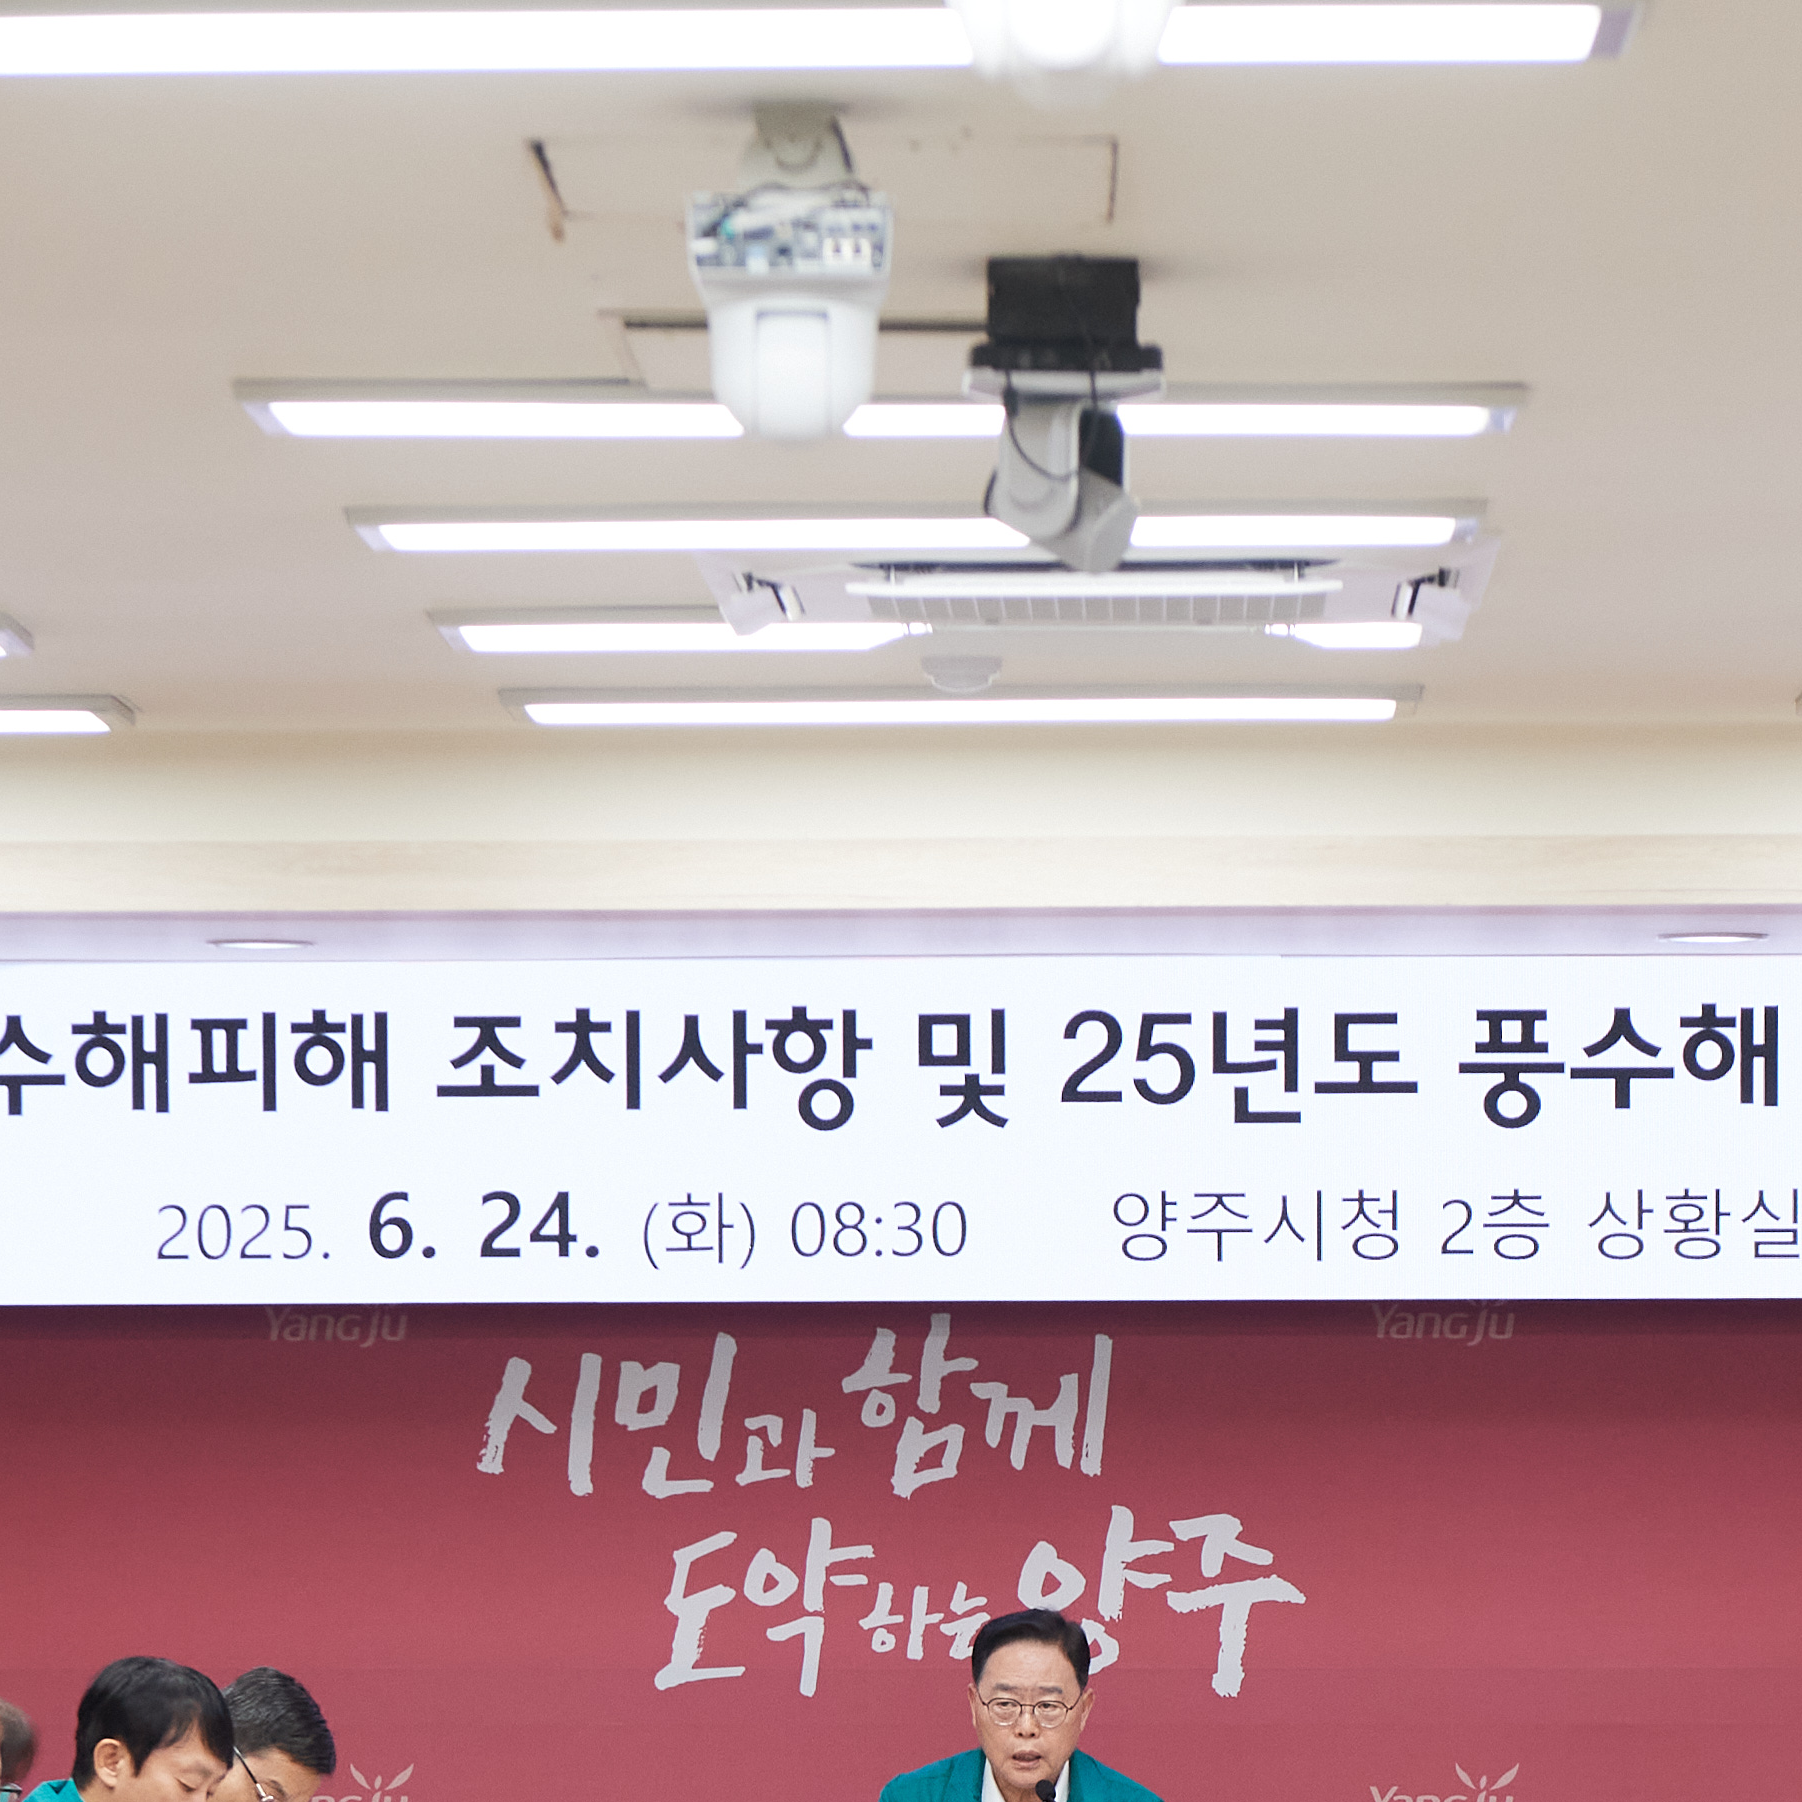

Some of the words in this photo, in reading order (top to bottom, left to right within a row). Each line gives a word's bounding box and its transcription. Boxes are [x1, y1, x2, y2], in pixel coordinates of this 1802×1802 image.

[436, 1005, 874, 1132] 조치사항
[918, 1008, 1010, 1129] 및
[1061, 1007, 1419, 1125] 25년도
[1458, 1003, 1780, 1130] 풍수해
[157, 1204, 331, 1261] 2025.
[368, 1191, 437, 1261] 6.
[480, 1190, 601, 1259] 24.
[641, 1191, 757, 1271] (화)
[791, 1201, 968, 1259] 08:30
[1112, 1189, 1401, 1263] 양주시청
[1441, 1190, 1551, 1262] 2층
[1588, 1188, 1802, 1261] 상황실
[477, 1331, 835, 1498] 시민과
[842, 1312, 1113, 1500] 함께
[1017, 1505, 1306, 1698] 양주
